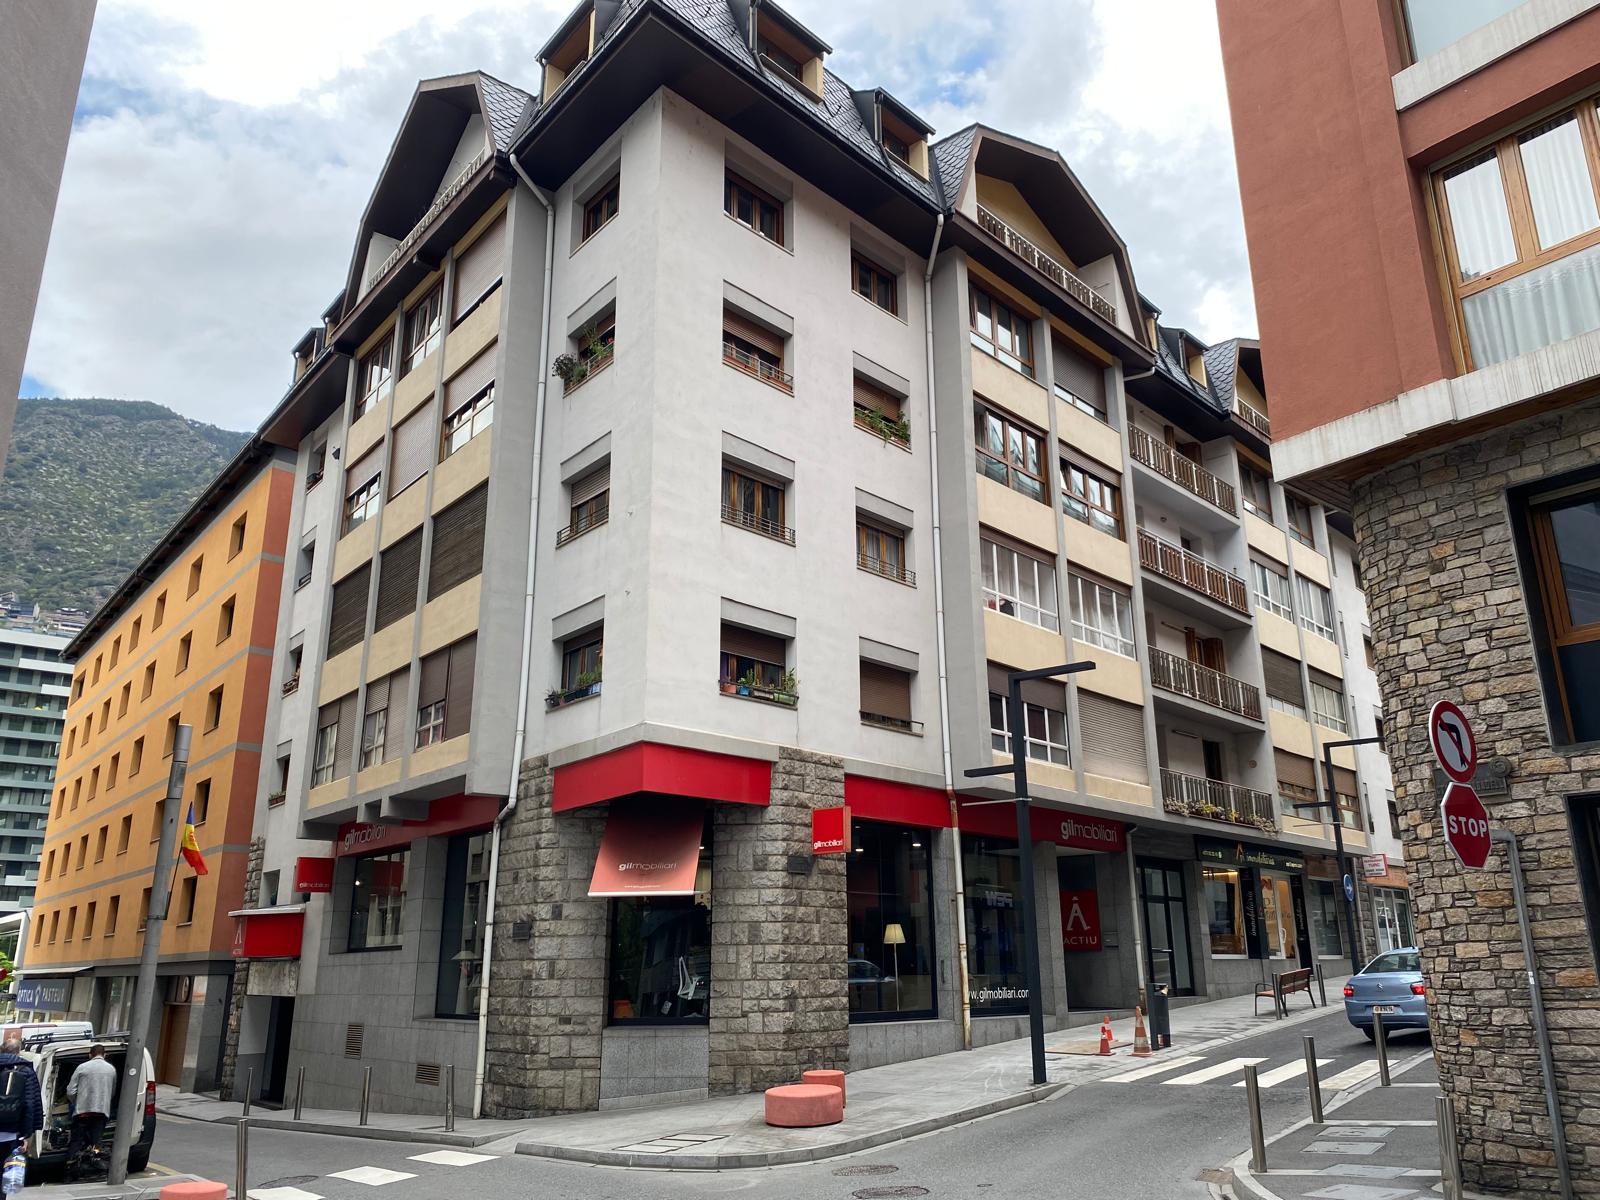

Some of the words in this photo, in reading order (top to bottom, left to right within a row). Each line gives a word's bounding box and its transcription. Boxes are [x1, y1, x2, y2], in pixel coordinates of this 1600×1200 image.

[1061, 819, 1117, 844] gilmobiliari
[1448, 815, 1487, 838] STOP
[814, 839, 843, 850] gilmobiliari
[618, 861, 677, 871] gilmobiliari
[1063, 935, 1097, 945] ACTIU
